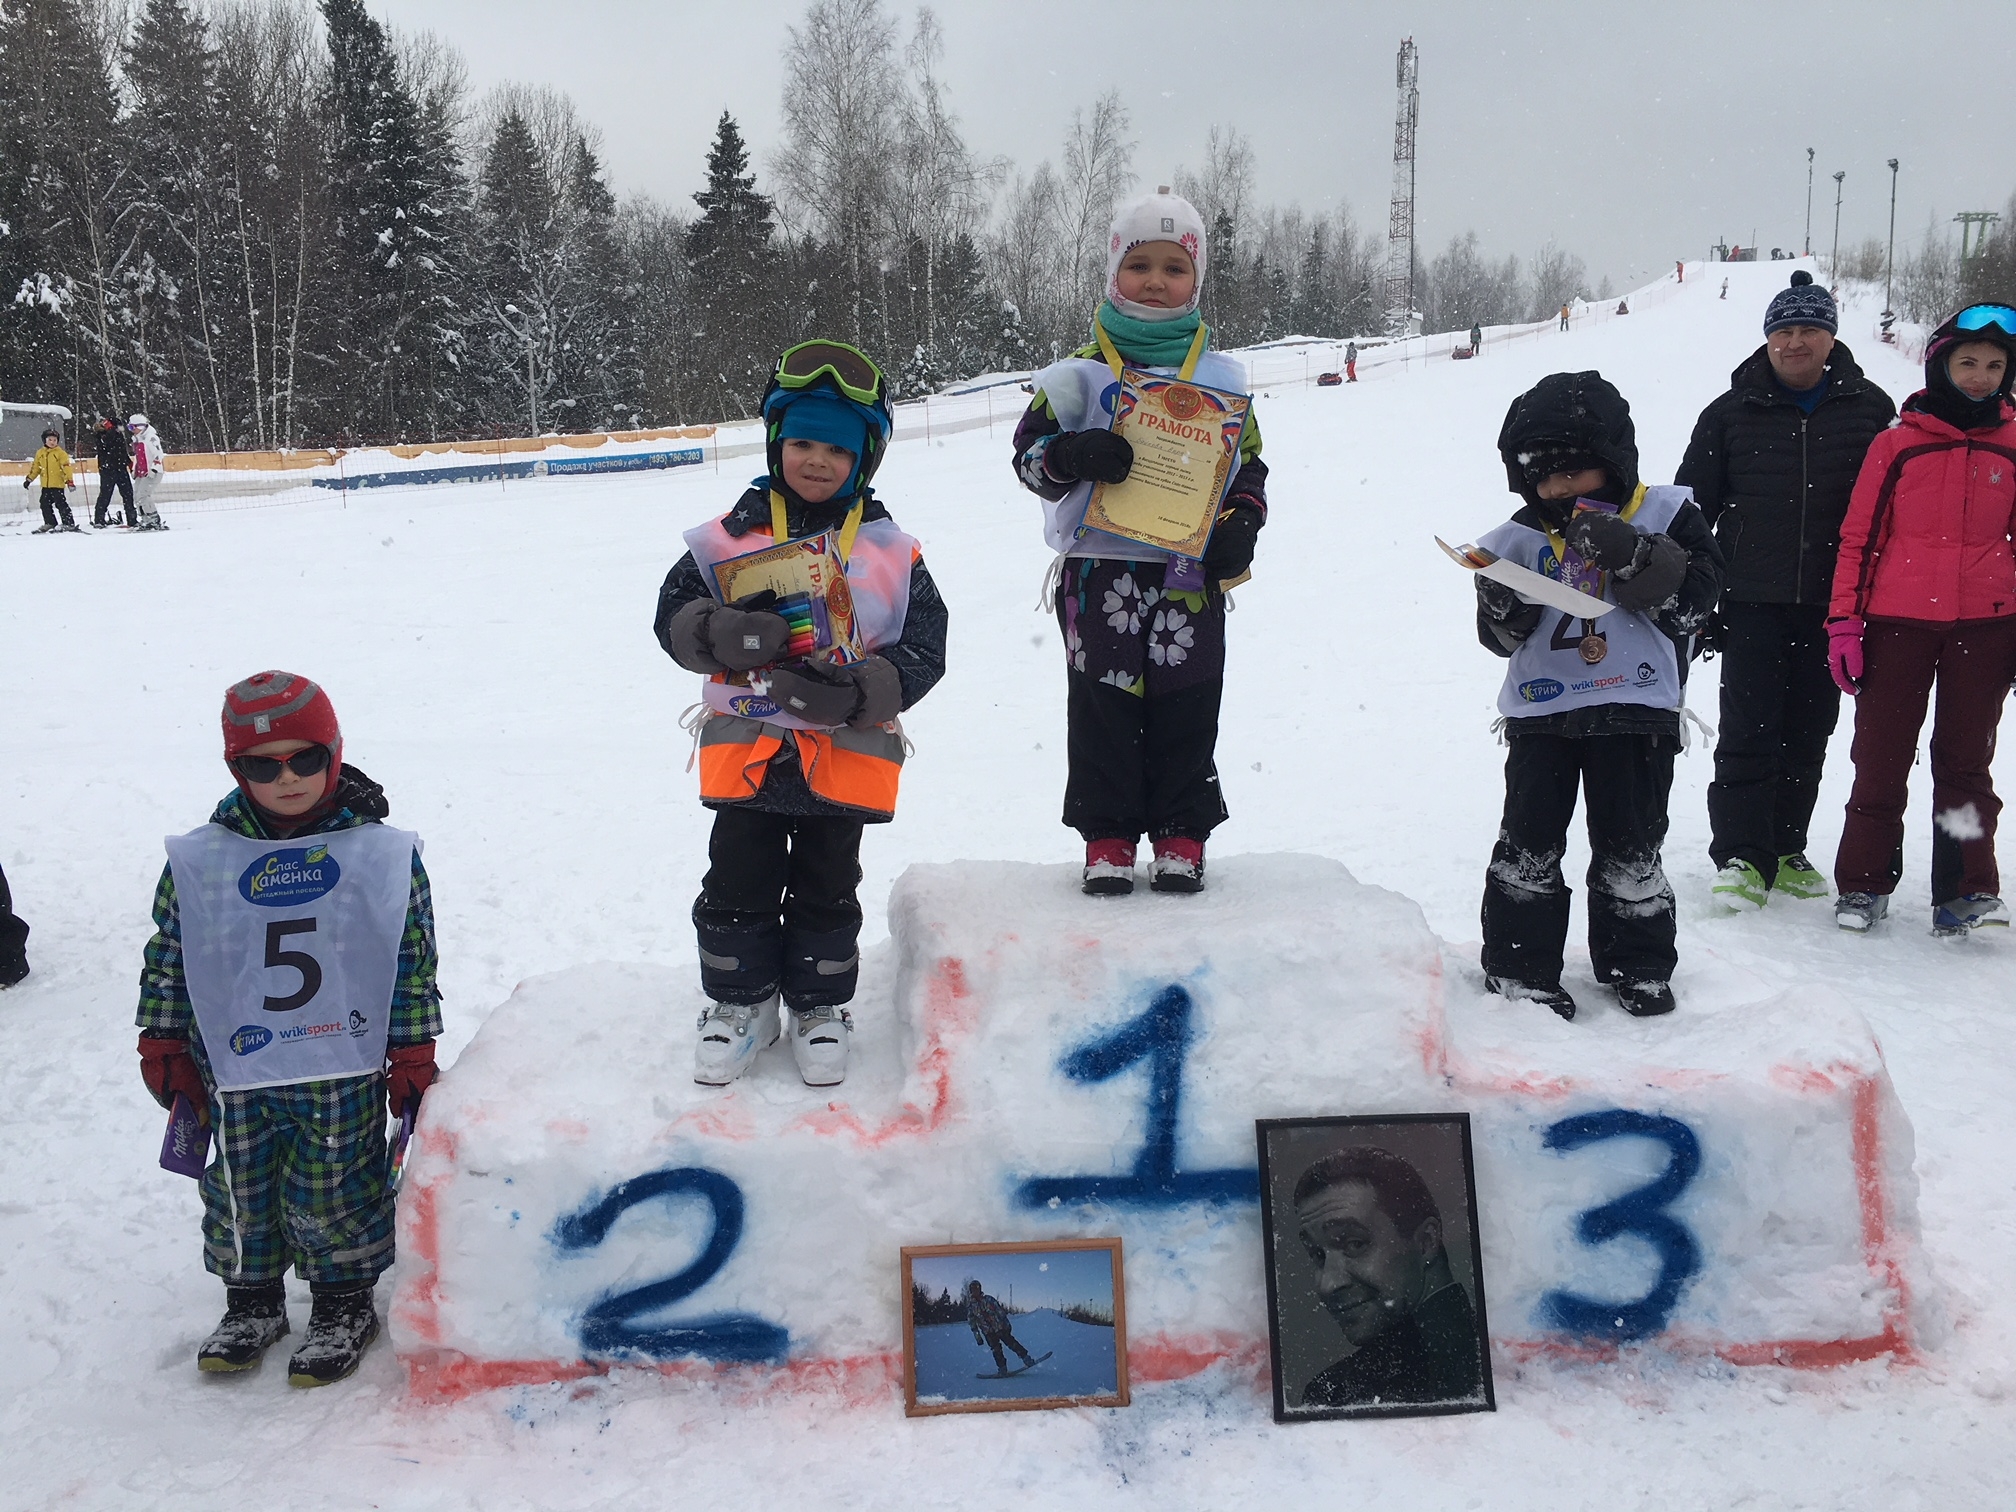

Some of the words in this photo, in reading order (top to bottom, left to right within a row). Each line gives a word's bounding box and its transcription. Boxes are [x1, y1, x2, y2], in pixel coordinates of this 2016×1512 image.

[1138, 412, 1212, 446] ГРАМОТА
[551, 463, 587, 474] Продажа
[588, 460, 623, 472] участков
[1550, 613, 1606, 665] 4
[250, 868, 322, 897] Каменка
[265, 857, 298, 874] Спас
[263, 917, 322, 1011] 5
[1014, 985, 1261, 1209] 1
[173, 1117, 188, 1158] Milka
[1542, 1109, 1702, 1340] 3
[551, 1167, 789, 1361] 2
